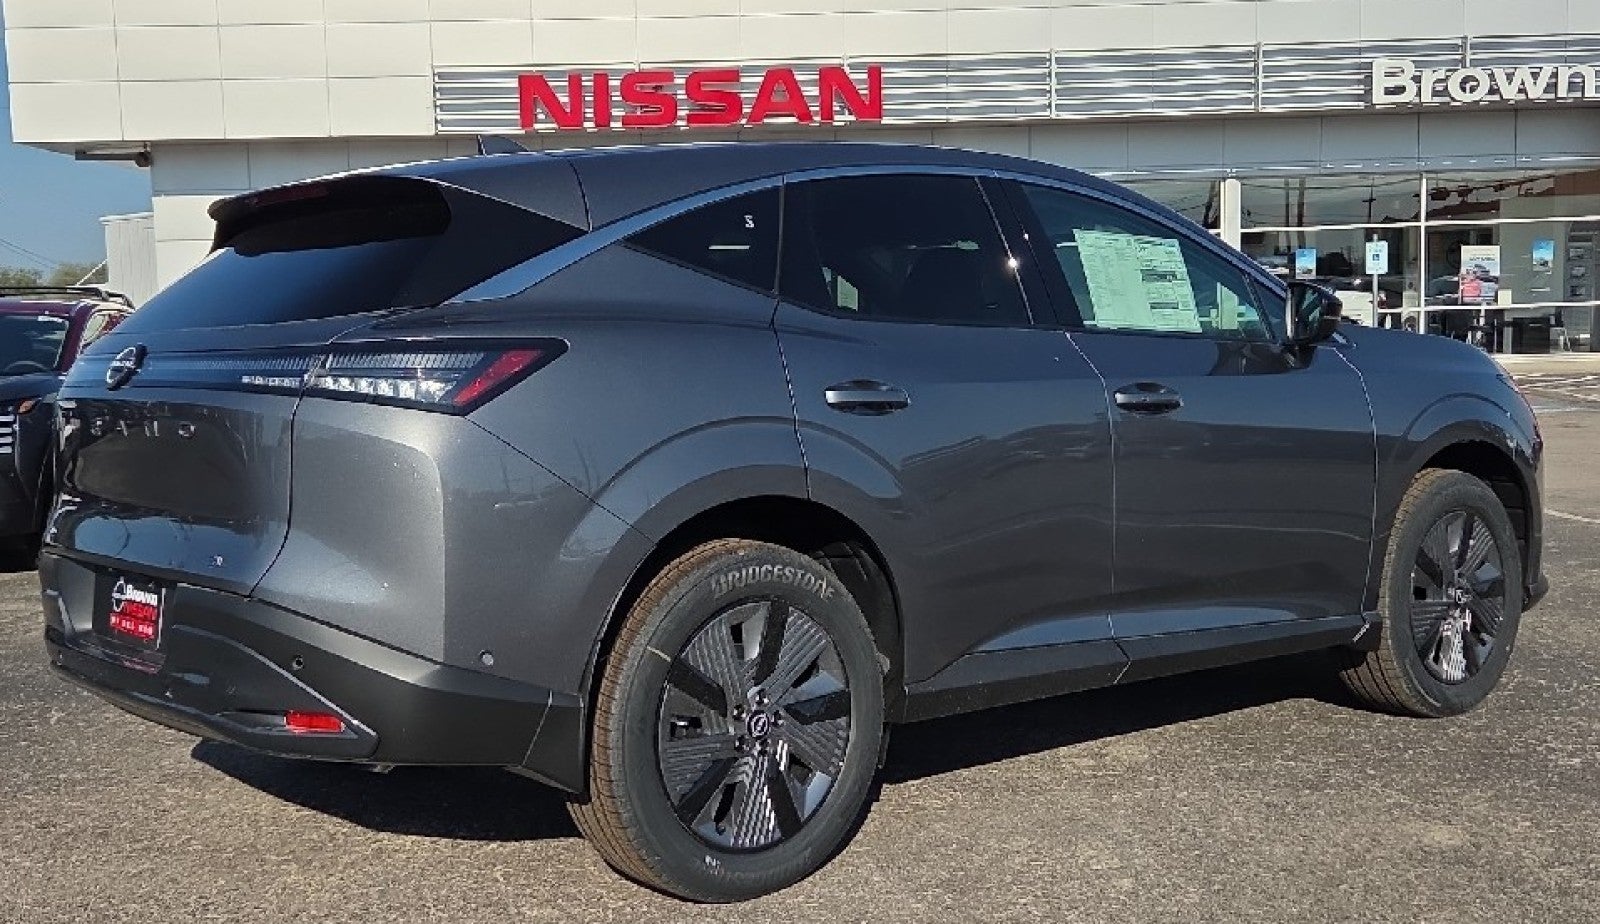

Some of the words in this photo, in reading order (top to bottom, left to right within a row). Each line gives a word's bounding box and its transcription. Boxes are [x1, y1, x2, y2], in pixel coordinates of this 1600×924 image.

[518, 65, 883, 130] NISSAN
[1372, 58, 1599, 103] Brown
[126, 584, 158, 607] Brown
[710, 564, 835, 600] BRIDGESTONE
